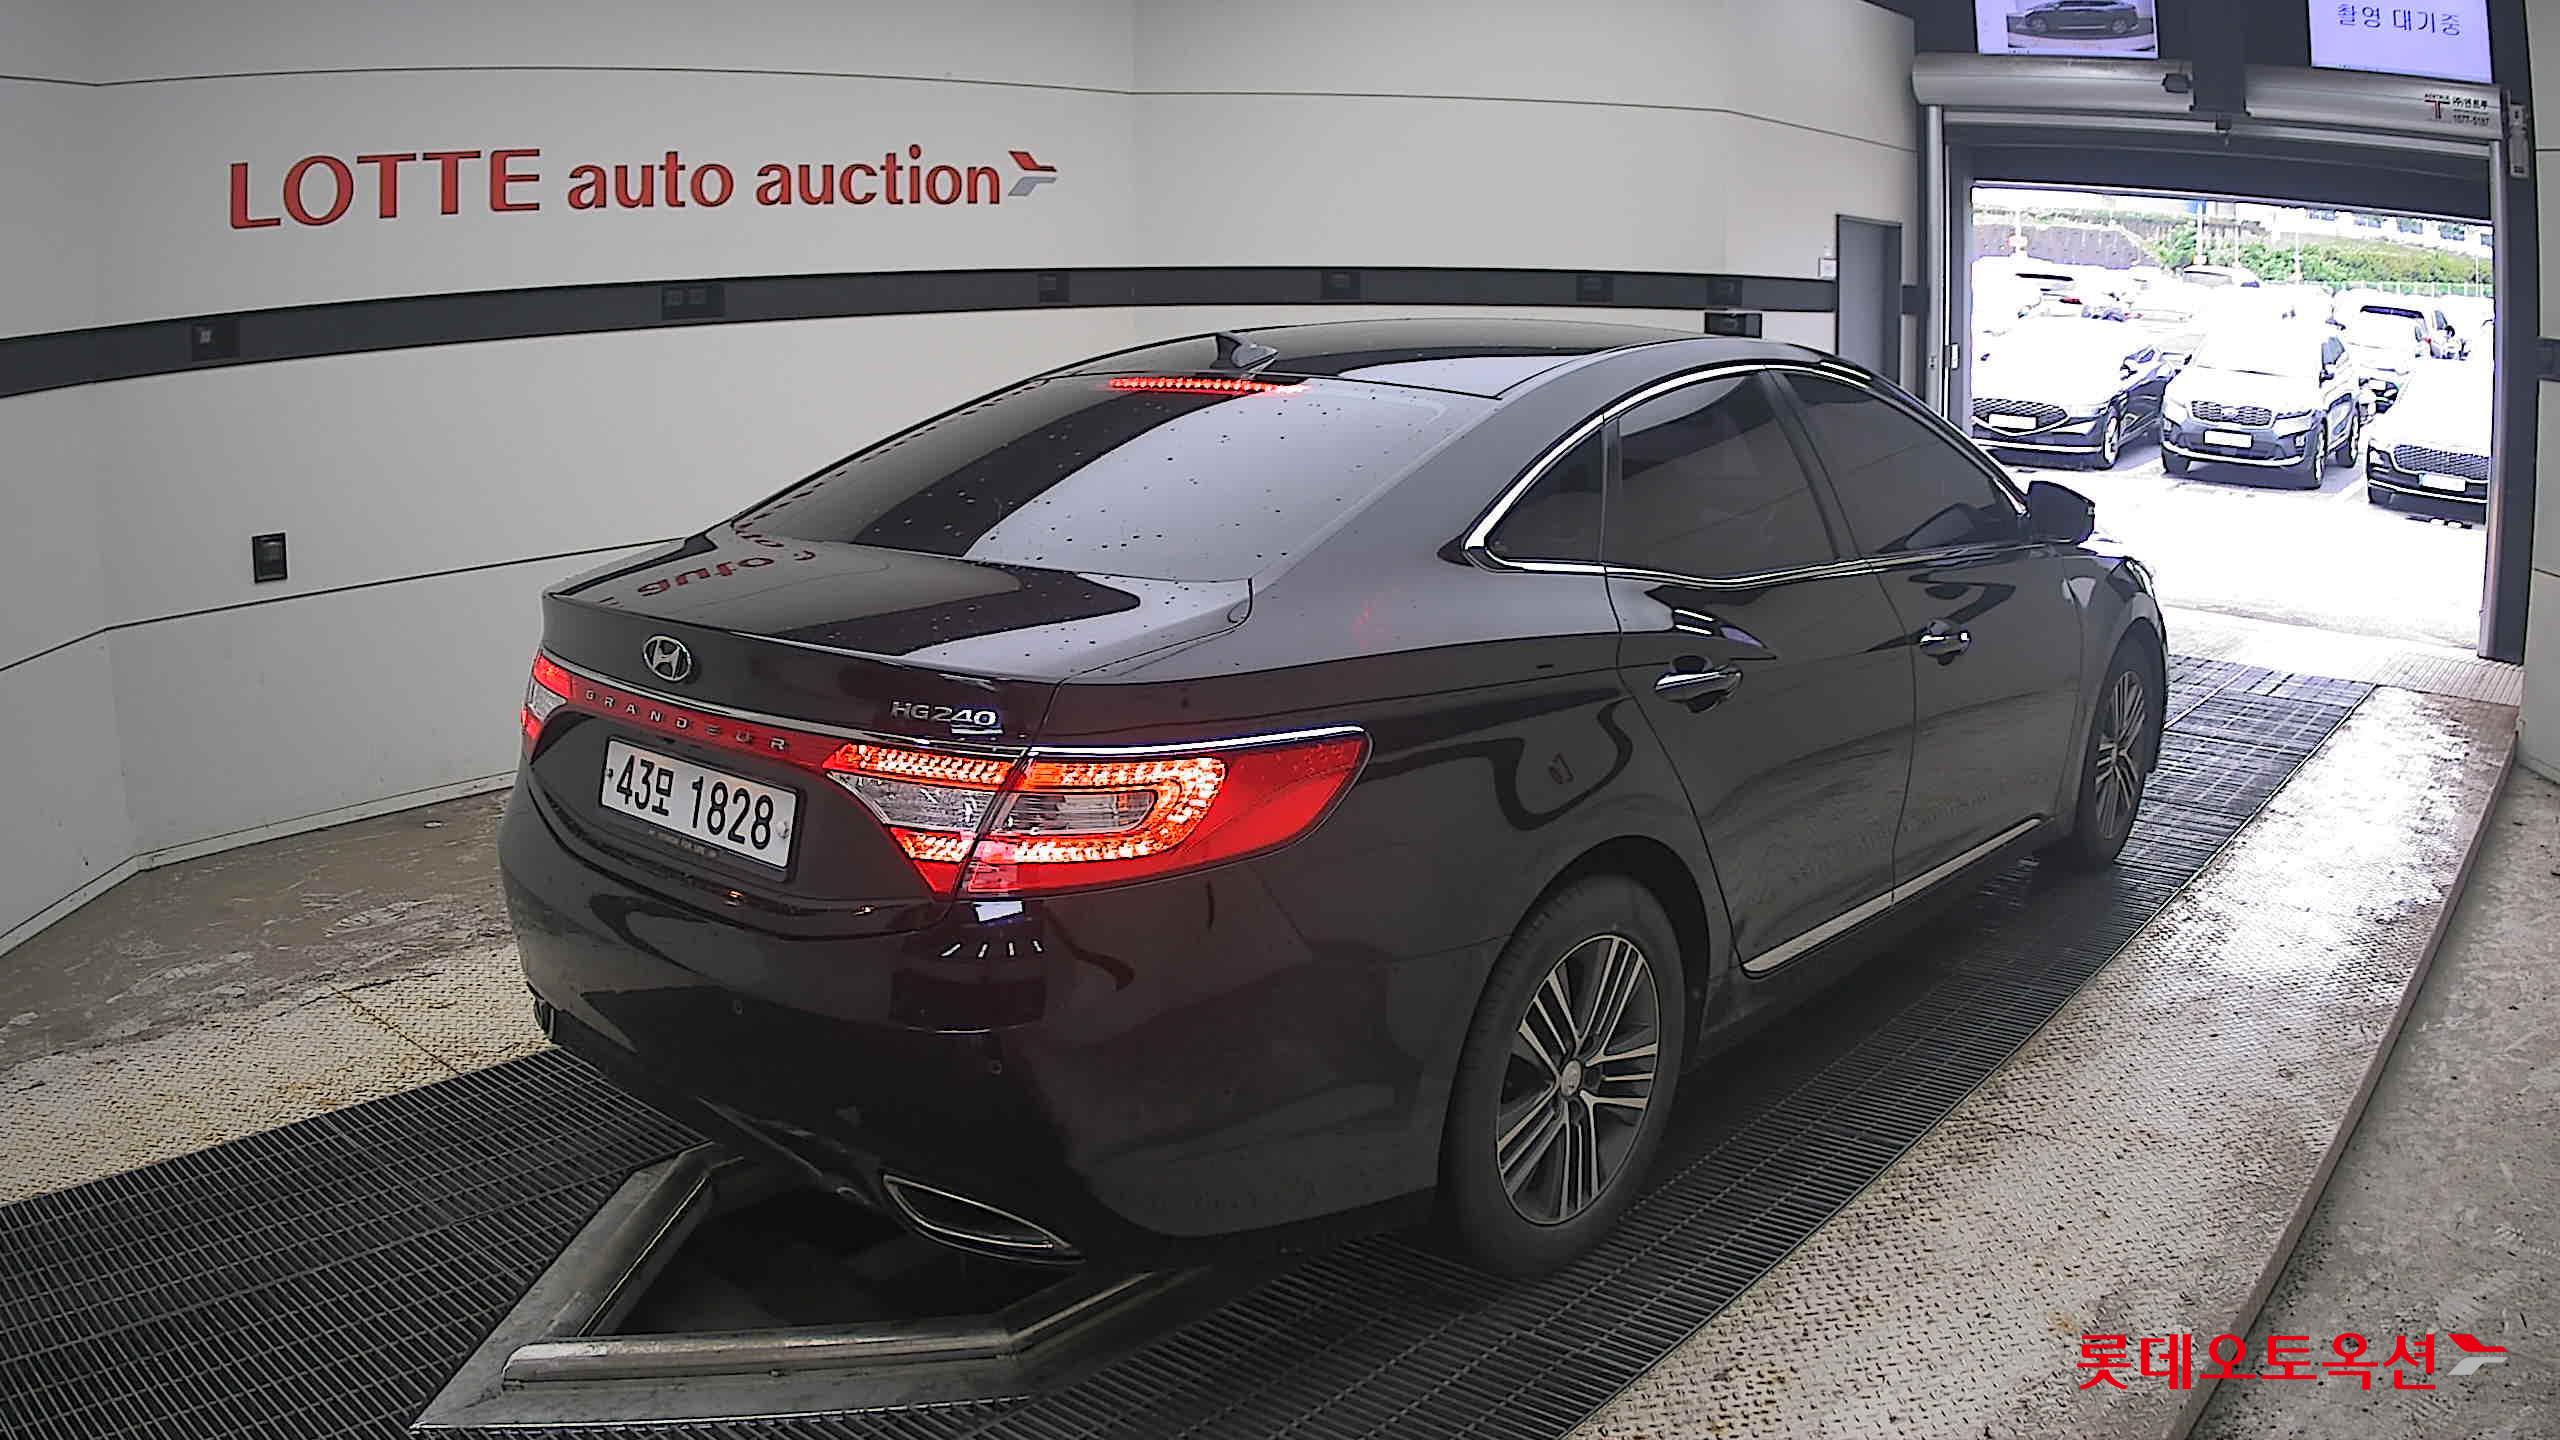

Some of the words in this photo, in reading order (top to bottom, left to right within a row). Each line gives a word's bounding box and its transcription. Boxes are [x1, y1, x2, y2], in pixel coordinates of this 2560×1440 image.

[2337, 4, 2381, 28] 촬영
[2393, 9, 2461, 36] 대기중
[229, 149, 541, 229] LOTTE
[568, 150, 734, 209] auto
[755, 144, 1001, 205] auction
[586, 690, 786, 750] GRANDEUR
[890, 701, 997, 726] HG240
[616, 755, 674, 817] 43모
[691, 775, 774, 850] 1828
